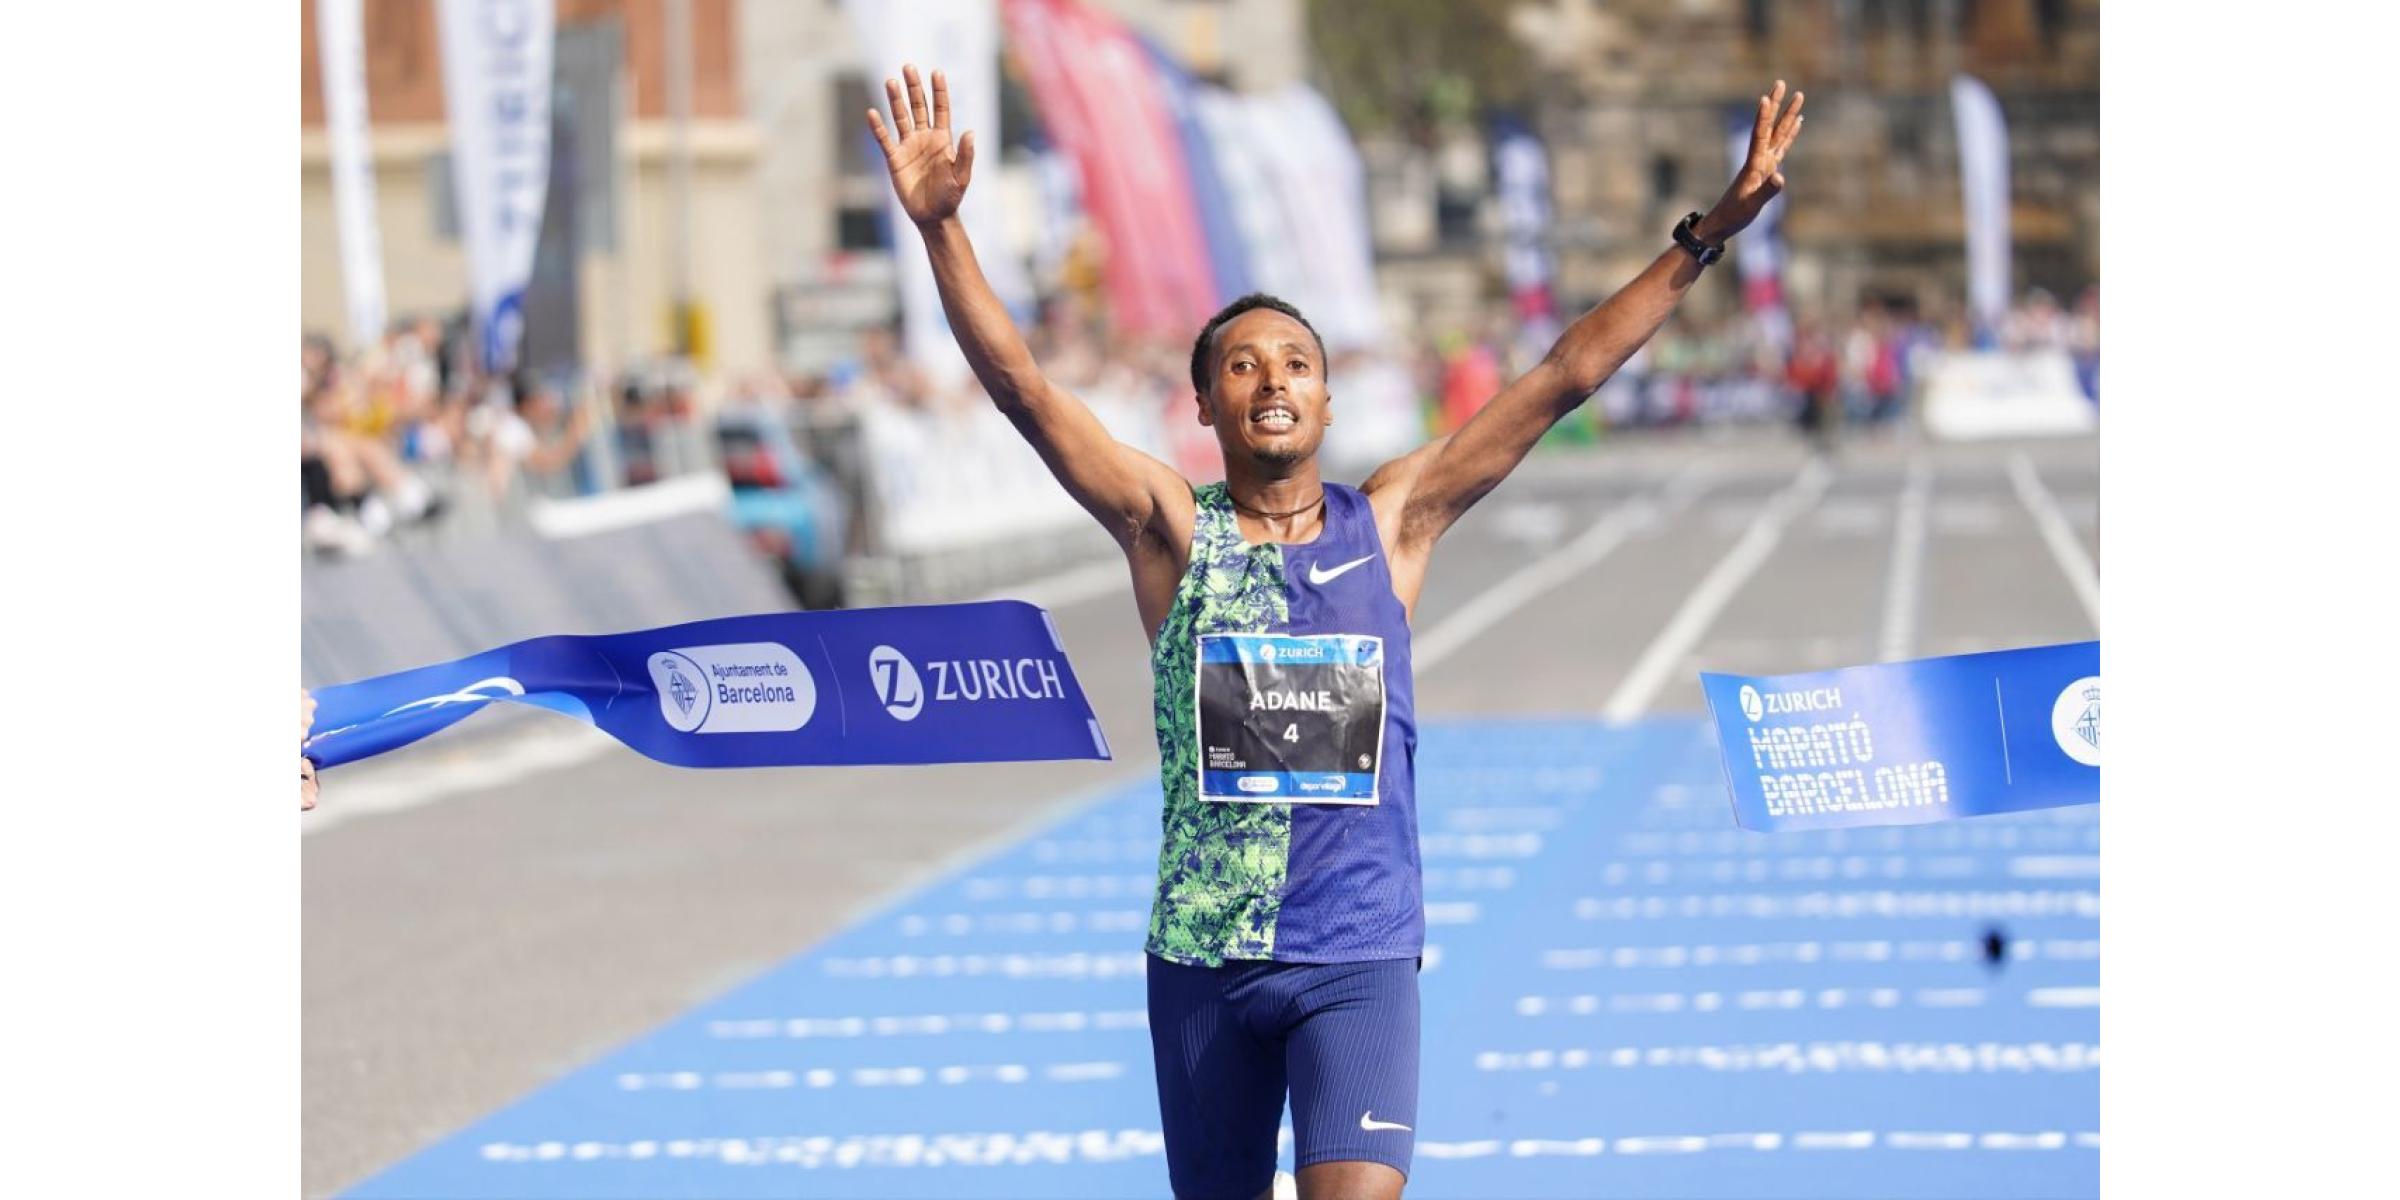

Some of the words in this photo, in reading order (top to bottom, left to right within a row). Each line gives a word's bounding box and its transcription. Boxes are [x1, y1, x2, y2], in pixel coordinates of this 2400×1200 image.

[1279, 647, 1324, 658] ZURICH
[712, 662, 773, 681] Ajuntament
[773, 662, 788, 677] de
[927, 658, 1066, 701] ZURICH
[717, 681, 795, 706] Barcelona
[1250, 690, 1332, 711] ADANE
[1763, 687, 1843, 714] ZURICH
[1282, 723, 1299, 743] 4
[1747, 711, 1874, 770] MARATÓ
[1760, 760, 1949, 817] BARCELONA
